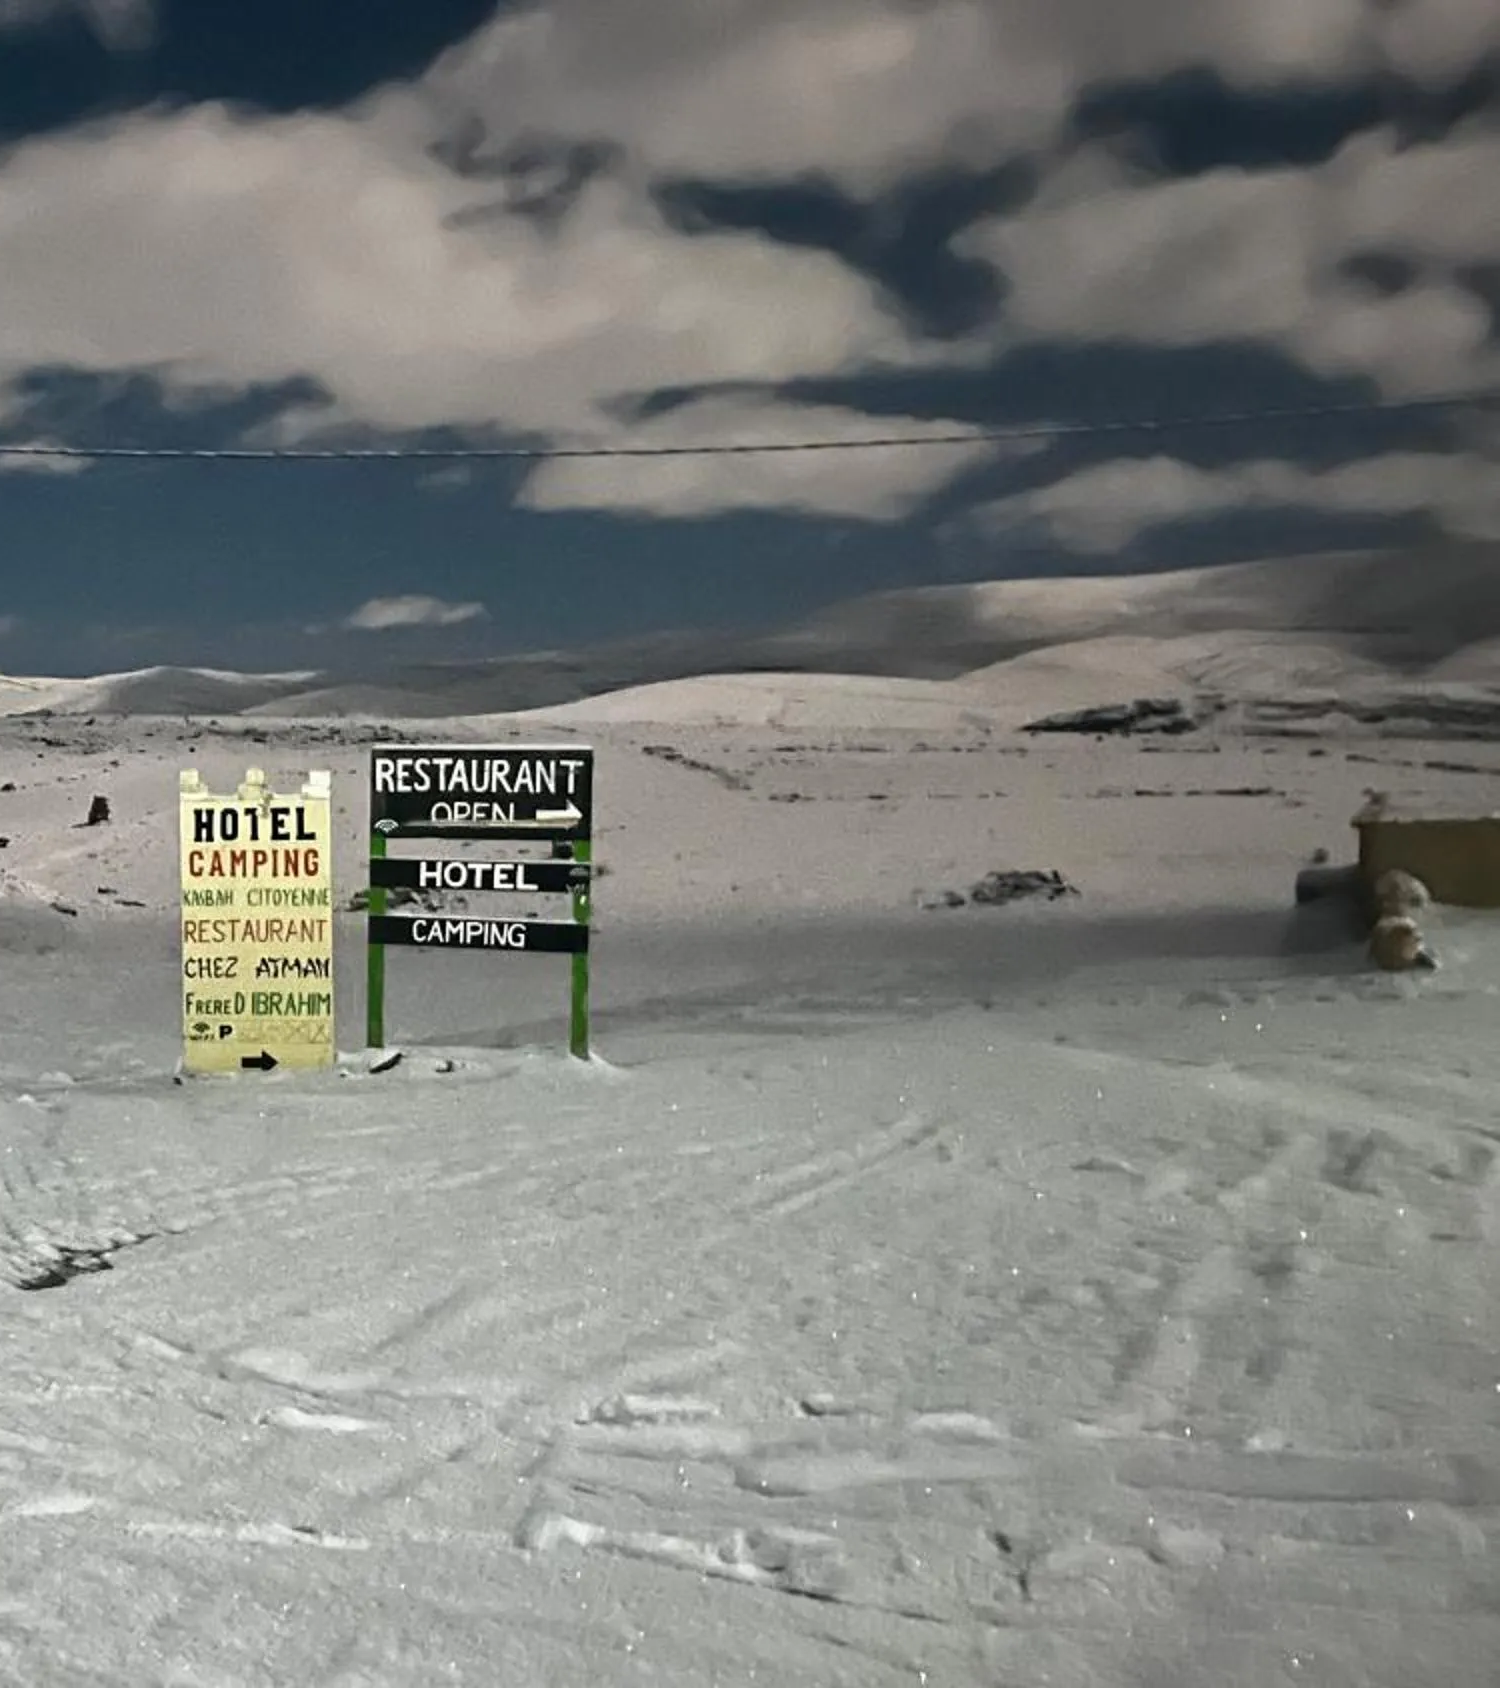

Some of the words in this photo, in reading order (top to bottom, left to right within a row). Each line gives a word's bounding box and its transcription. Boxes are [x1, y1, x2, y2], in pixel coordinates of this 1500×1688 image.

[375, 758, 584, 795] RESTAURANT
[194, 807, 316, 843] HOTEL
[431, 801, 515, 822] OPEN
[189, 849, 320, 878] CAMPING
[419, 861, 538, 891] HOTEL
[247, 887, 329, 906] CITOYENNE
[184, 919, 327, 943] RESTAURANT
[412, 919, 527, 948] CAMPING
[184, 956, 238, 978] CHEZ
[255, 957, 330, 978] ATMAN
[252, 991, 331, 1016] IBRAHIM
